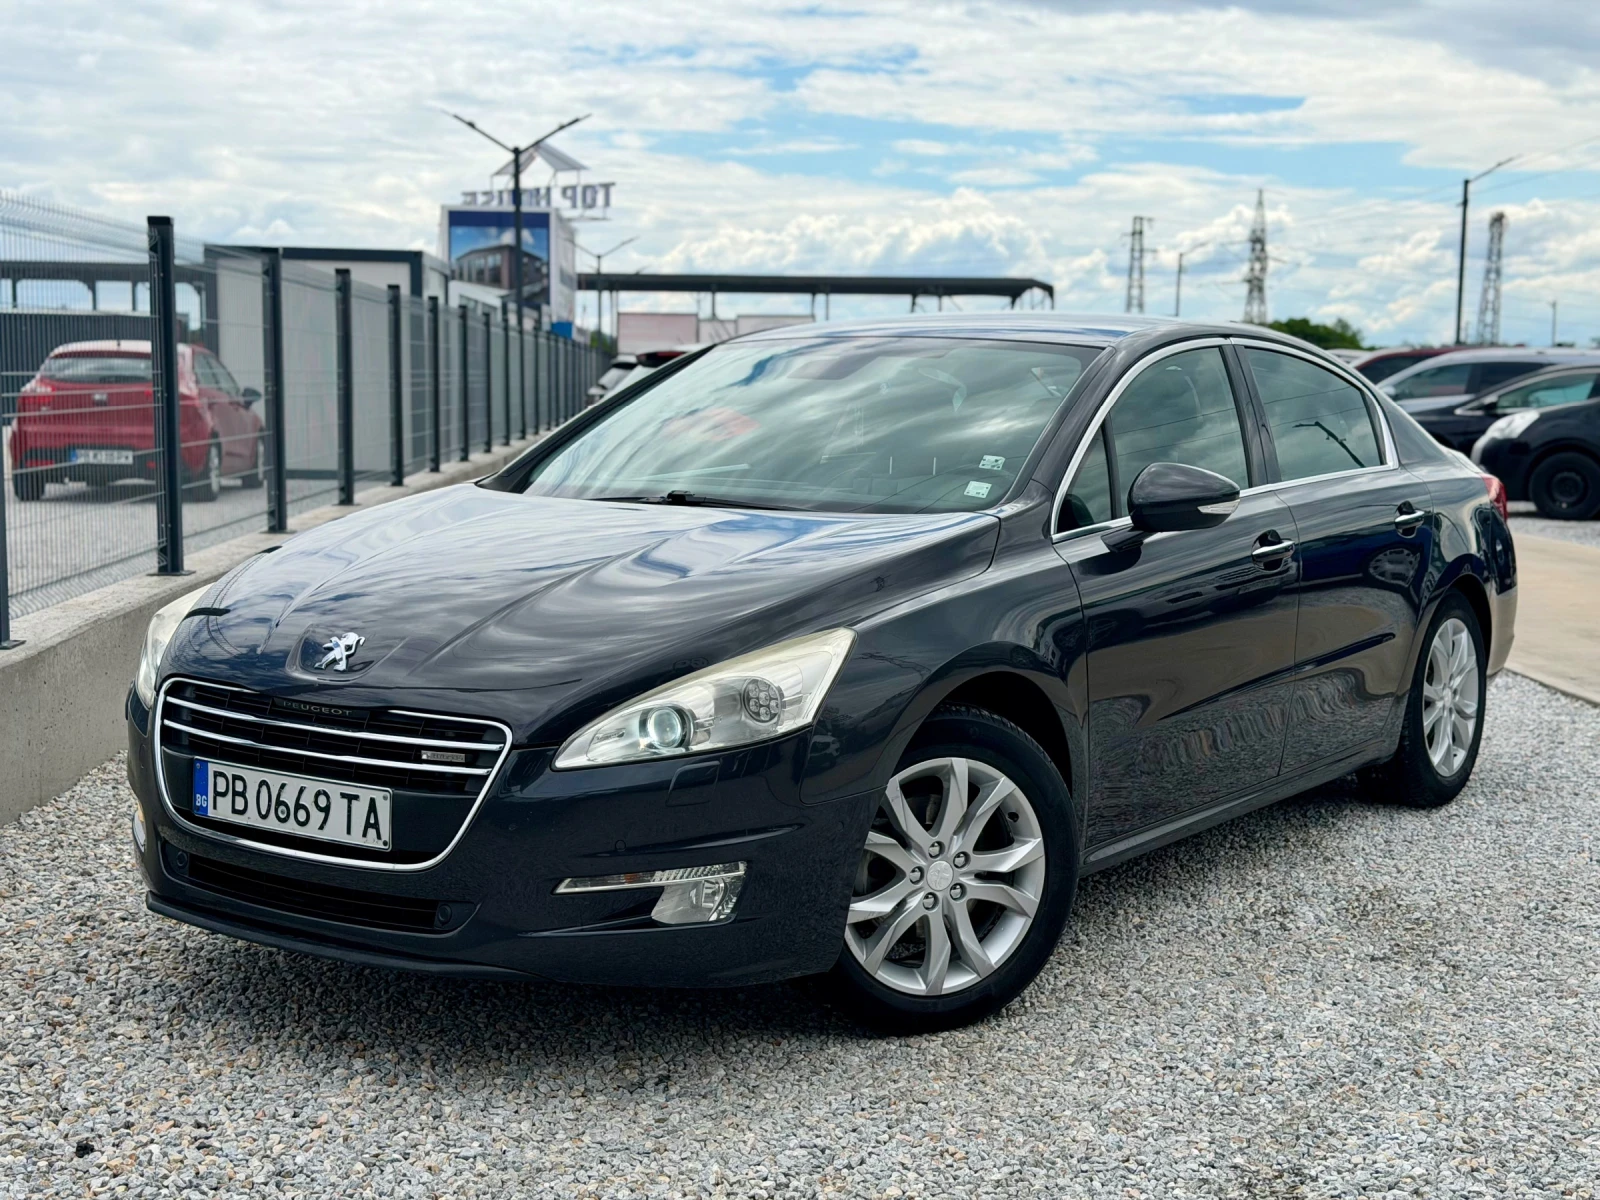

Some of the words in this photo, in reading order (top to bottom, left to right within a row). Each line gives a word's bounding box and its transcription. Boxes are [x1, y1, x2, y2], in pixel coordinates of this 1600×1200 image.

[283, 701, 353, 716] PEUGEOT
[195, 793, 208, 808] BG
[212, 769, 249, 816] PB
[255, 779, 332, 831] 0669
[339, 791, 382, 841] TA
